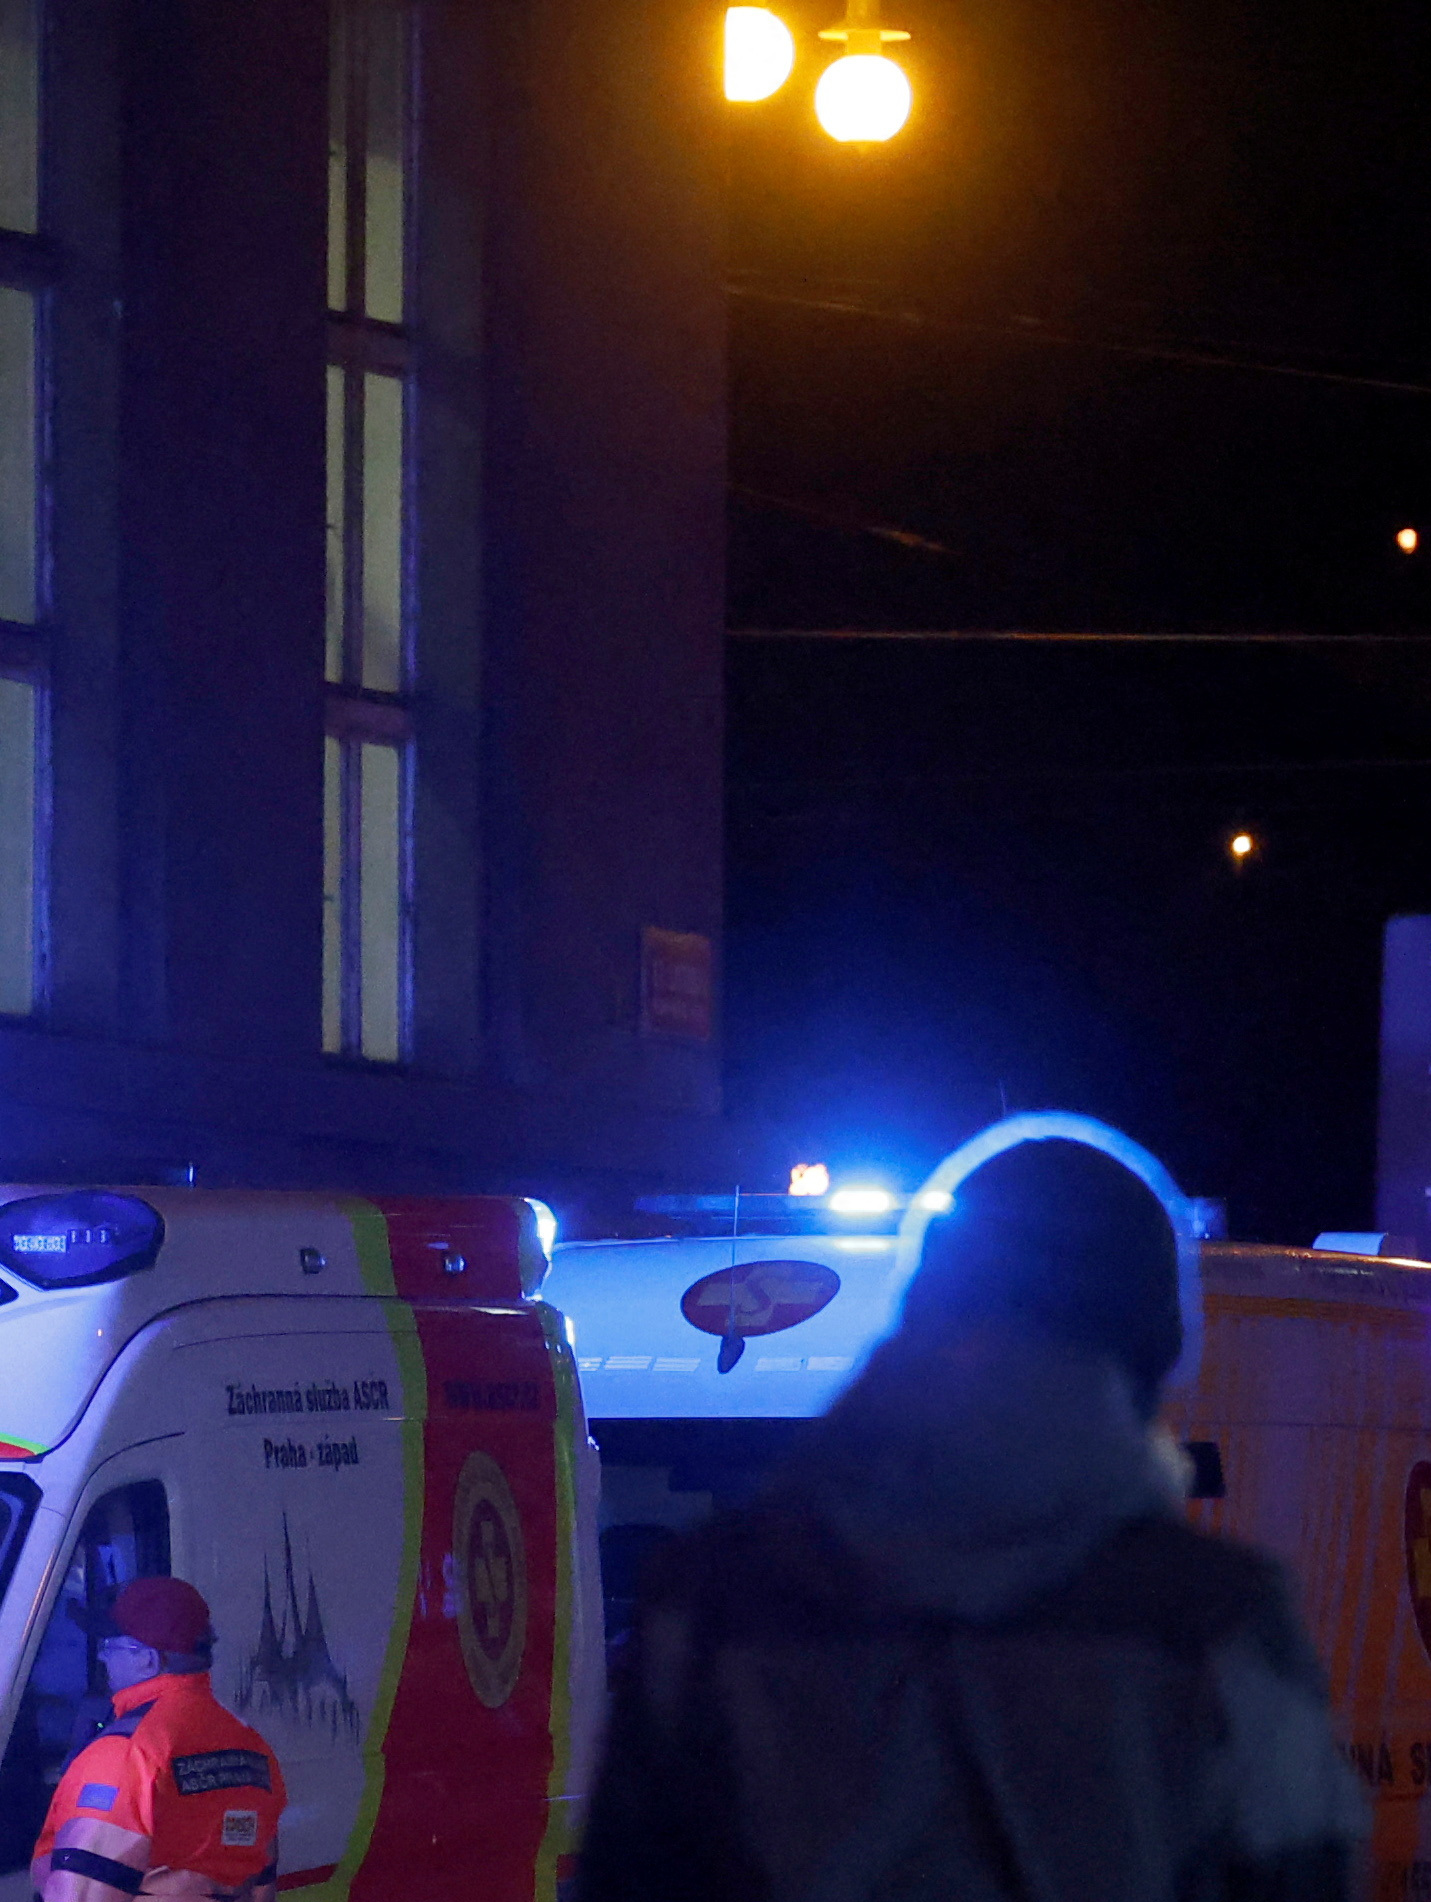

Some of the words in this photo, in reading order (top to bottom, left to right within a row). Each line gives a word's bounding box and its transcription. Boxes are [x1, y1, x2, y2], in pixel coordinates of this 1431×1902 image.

[226, 1382, 303, 1415] Záchranná
[306, 1379, 350, 1412] služba
[264, 1437, 307, 1469] Praha
[317, 1433, 359, 1472] západ
